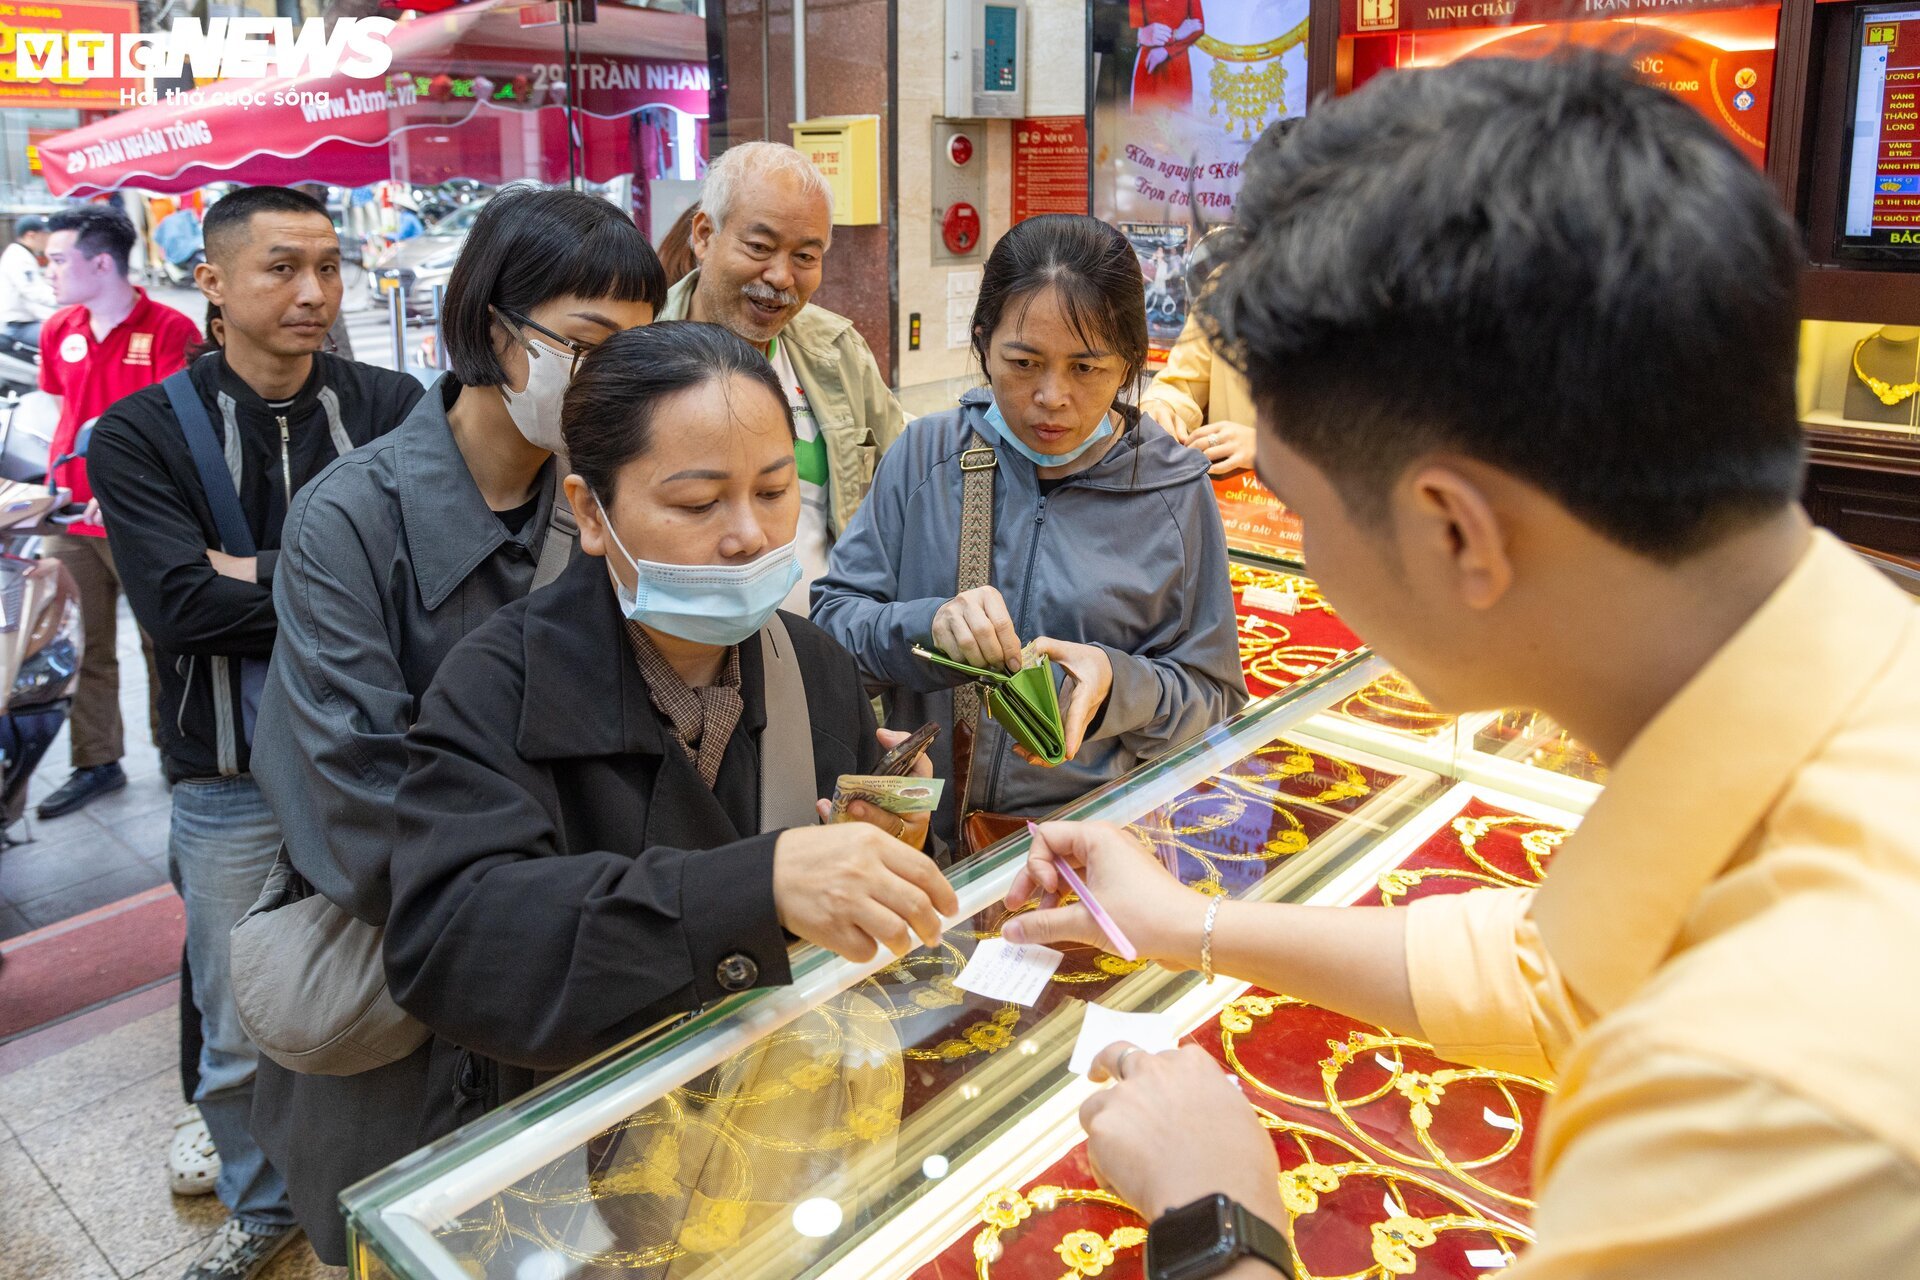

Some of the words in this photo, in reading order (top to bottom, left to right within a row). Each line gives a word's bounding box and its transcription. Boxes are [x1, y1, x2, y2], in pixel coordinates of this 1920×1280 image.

[1427, 5, 1468, 20] MINH
[1471, 1, 1517, 17] CHÂU
[532, 64, 564, 90] 29
[571, 57, 641, 90] TRẦN
[646, 61, 711, 91] NHÂN
[1669, 80, 1699, 91] LONG
[1886, 123, 1915, 131] LONG
[66, 150, 87, 174] 29
[164, 119, 213, 150] TÔNG
